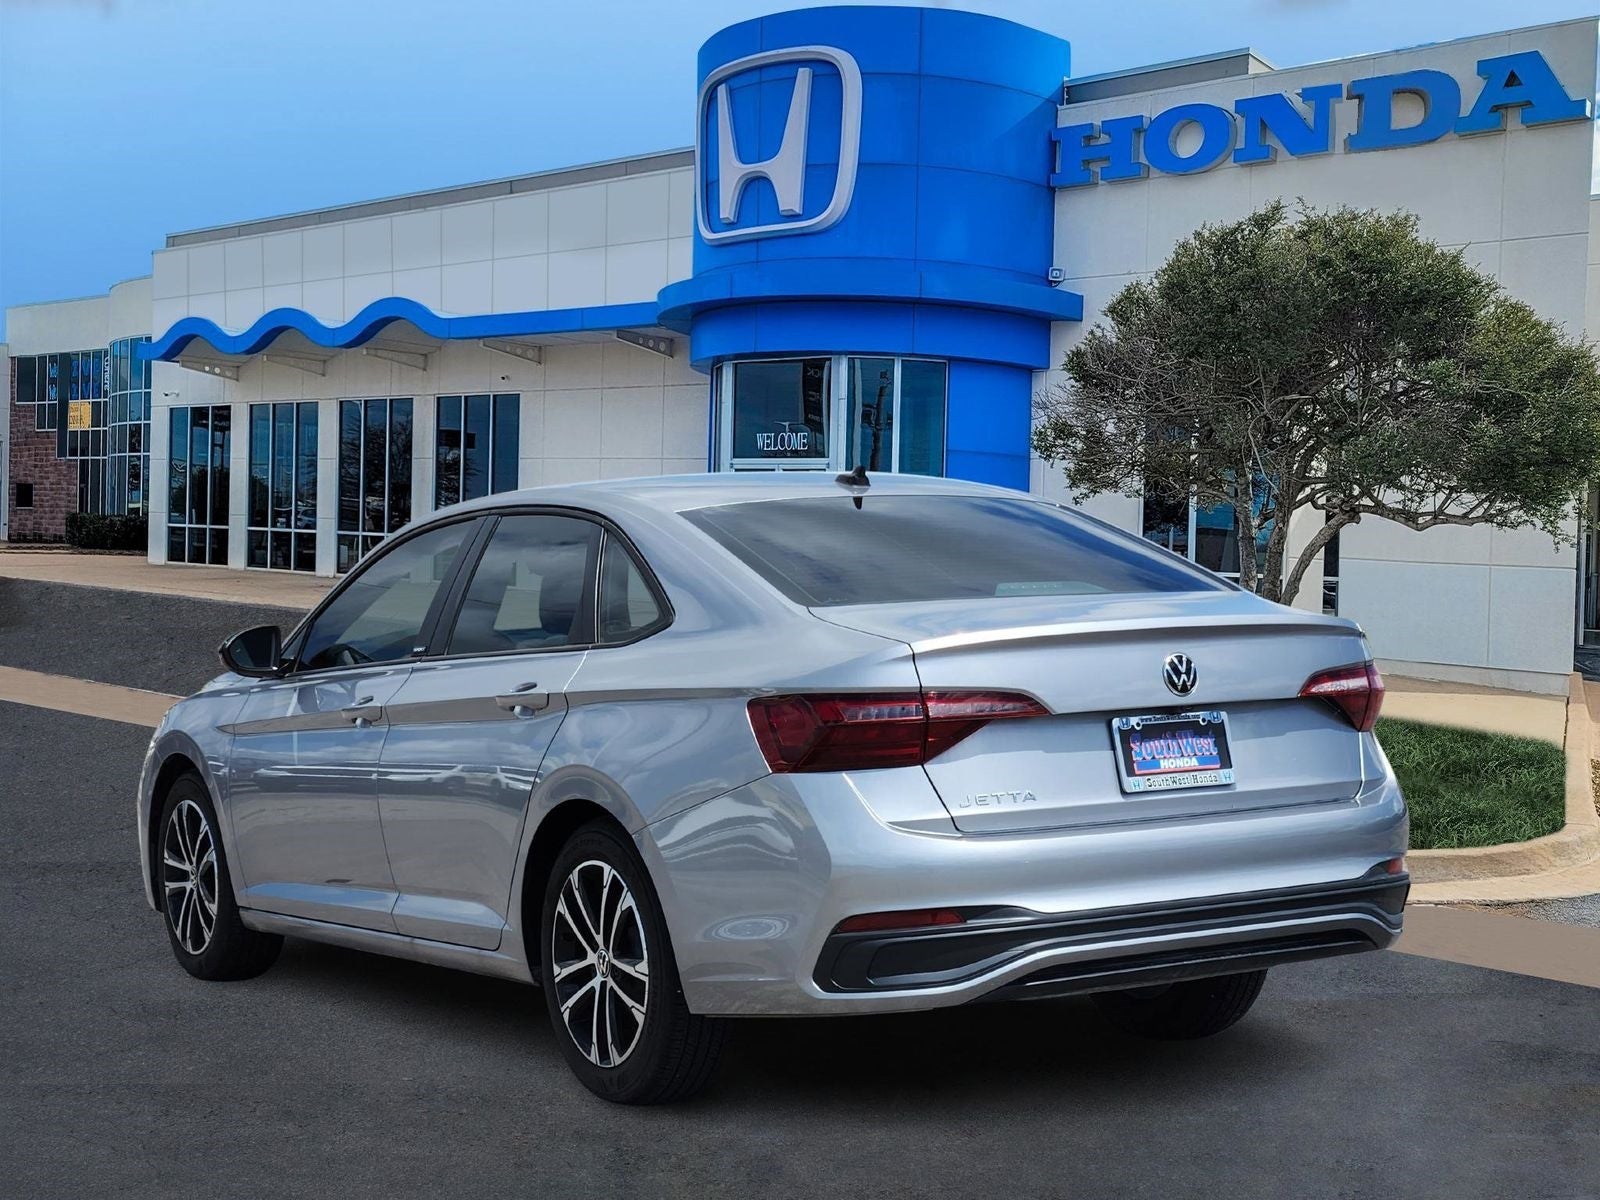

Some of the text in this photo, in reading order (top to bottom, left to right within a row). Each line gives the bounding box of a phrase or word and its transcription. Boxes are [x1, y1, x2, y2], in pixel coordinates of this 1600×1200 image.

[1049, 50, 1593, 188] HONDA
[756, 432, 808, 451] WELCOME
[1159, 757, 1199, 769] HONDA
[1191, 773, 1218, 785] Honda
[959, 790, 1038, 809] JETTA
